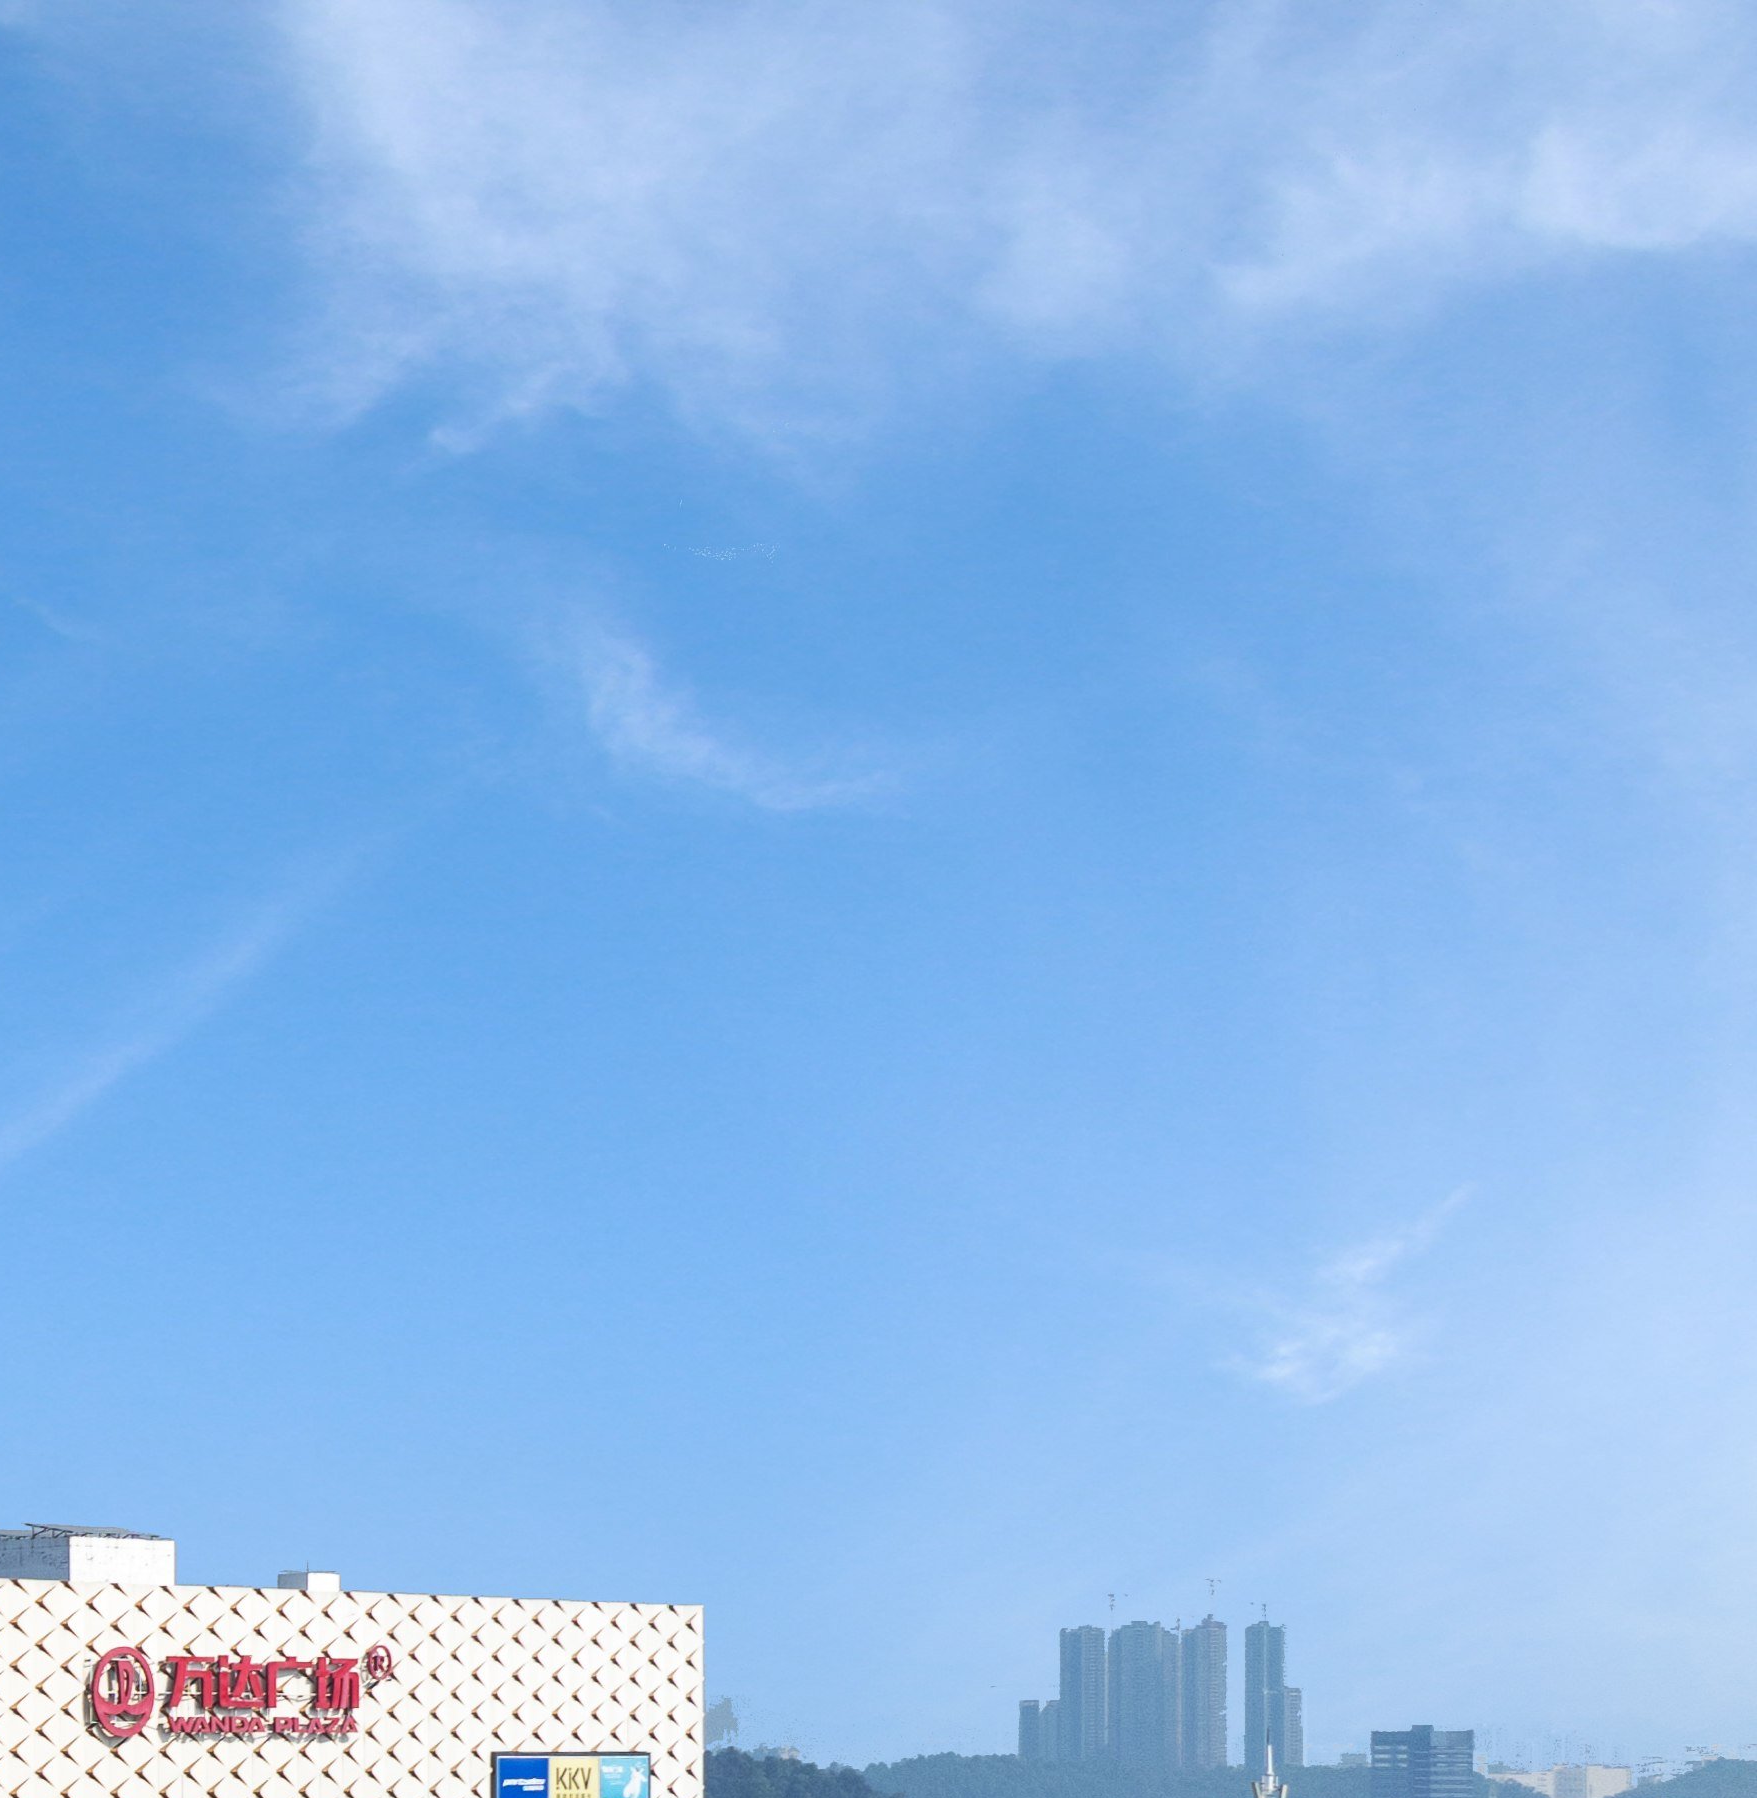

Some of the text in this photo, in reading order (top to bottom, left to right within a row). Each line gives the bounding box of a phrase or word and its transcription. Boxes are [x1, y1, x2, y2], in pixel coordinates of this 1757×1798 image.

[165, 1655, 360, 1709] 万达广场
[167, 1715, 360, 1734] WANDA PLAZA
